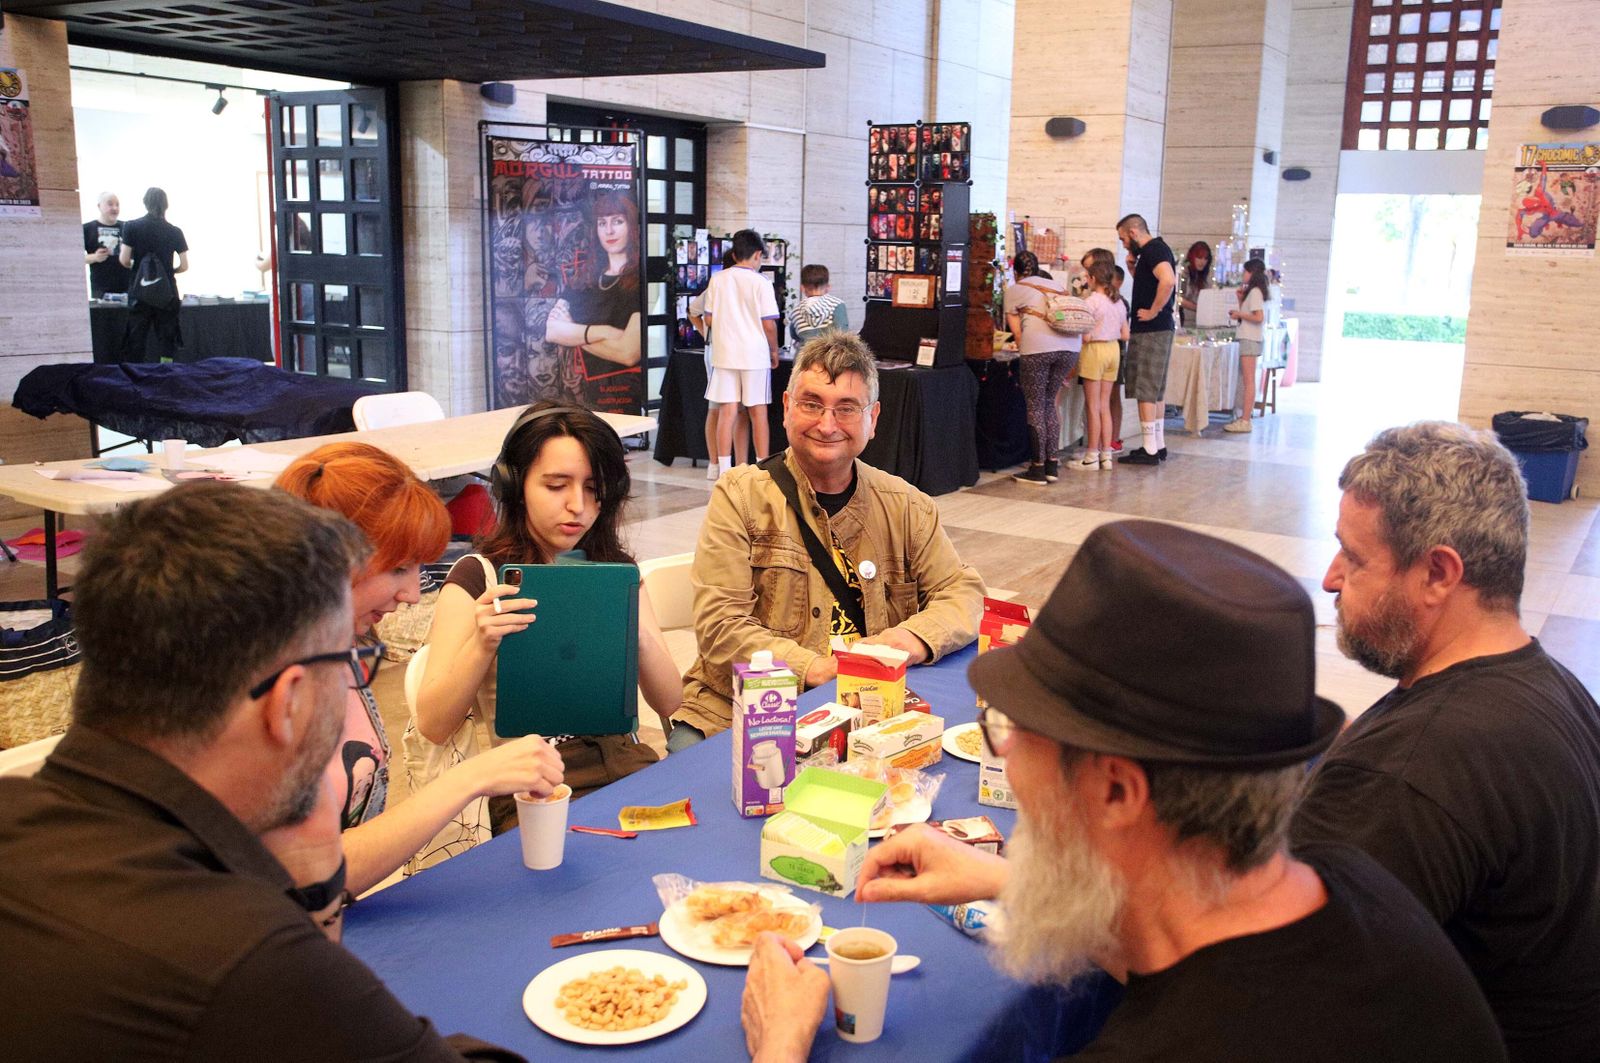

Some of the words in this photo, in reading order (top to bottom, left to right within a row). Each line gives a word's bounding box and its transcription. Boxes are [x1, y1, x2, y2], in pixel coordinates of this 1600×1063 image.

[493, 160, 581, 179] MORGUL
[582, 169, 632, 180] TATTOO
[748, 717, 760, 726] No
